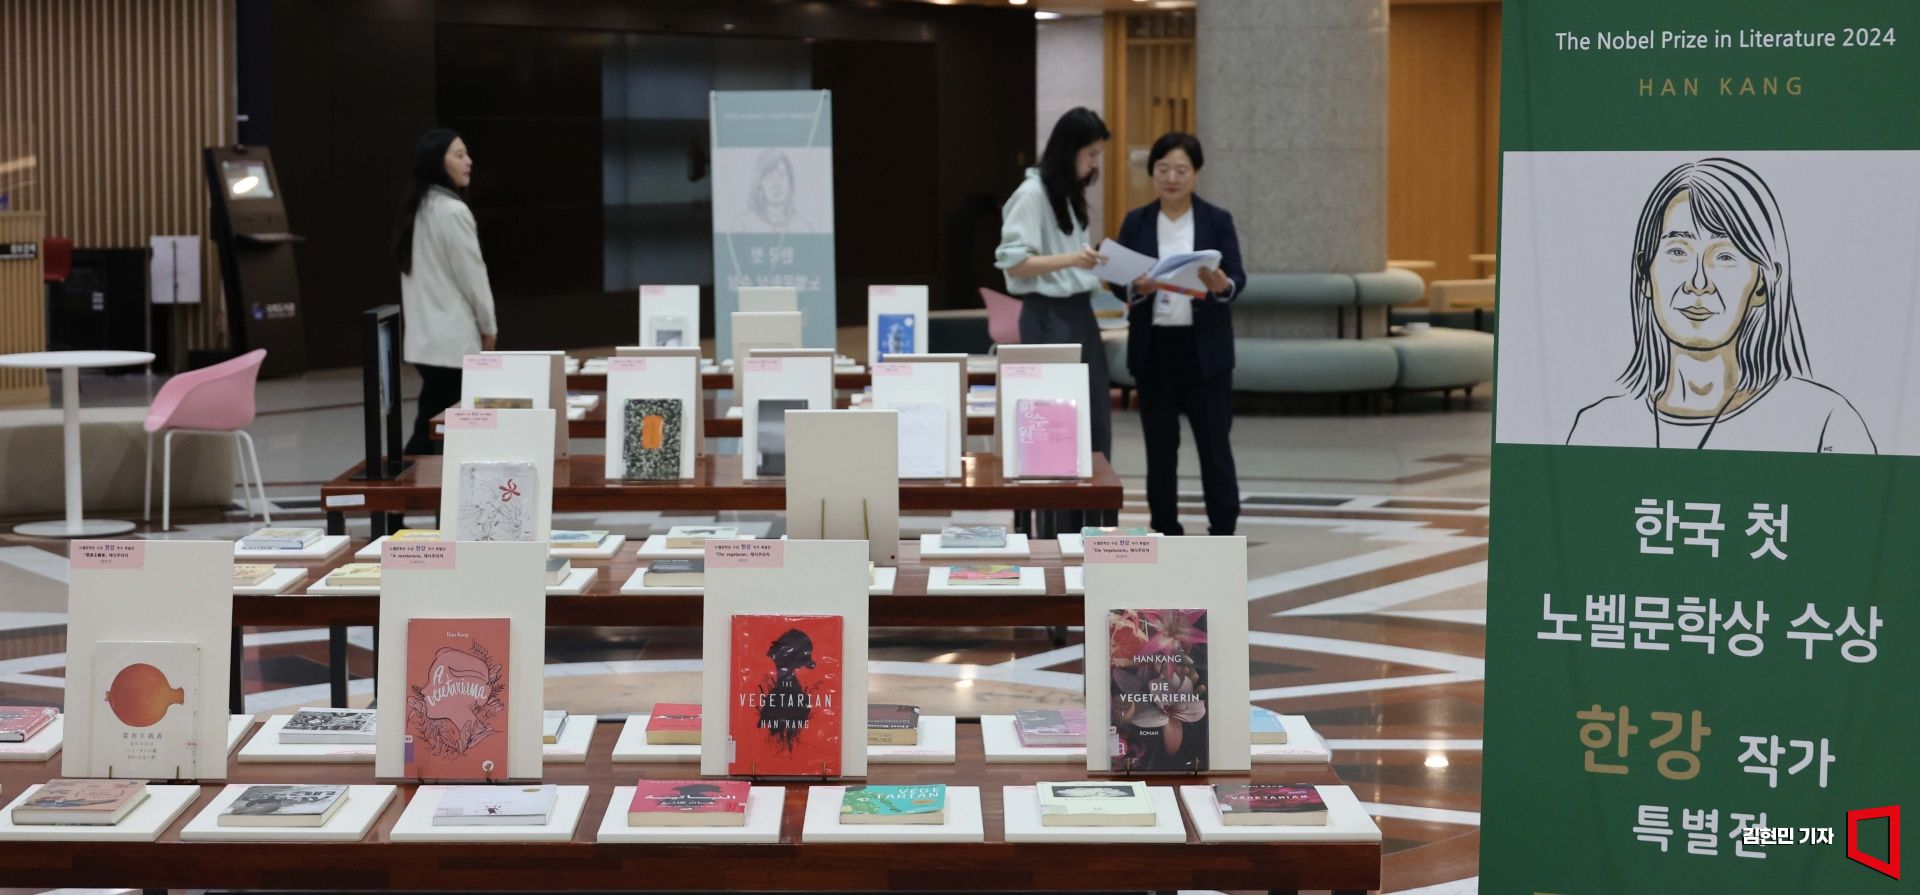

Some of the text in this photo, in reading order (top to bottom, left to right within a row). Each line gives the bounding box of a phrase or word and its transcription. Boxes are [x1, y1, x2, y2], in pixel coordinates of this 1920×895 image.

[1555, 27, 1896, 50] The Nobel Prize in Literature 2024
[1639, 76, 1803, 96] HAN KANG
[1634, 498, 1789, 561] 한국 첫
[1537, 593, 1883, 663] 노벨문학상 수상
[1133, 654, 1182, 663] HAN KANG
[1151, 682, 1169, 691] DIE
[739, 693, 832, 708] VEGETARIAN
[1120, 693, 1200, 703] VEGETARIERIN
[760, 719, 809, 729] HAN KANG
[1576, 703, 1836, 788] 한강 작가
[1632, 804, 1768, 859] 특별전
